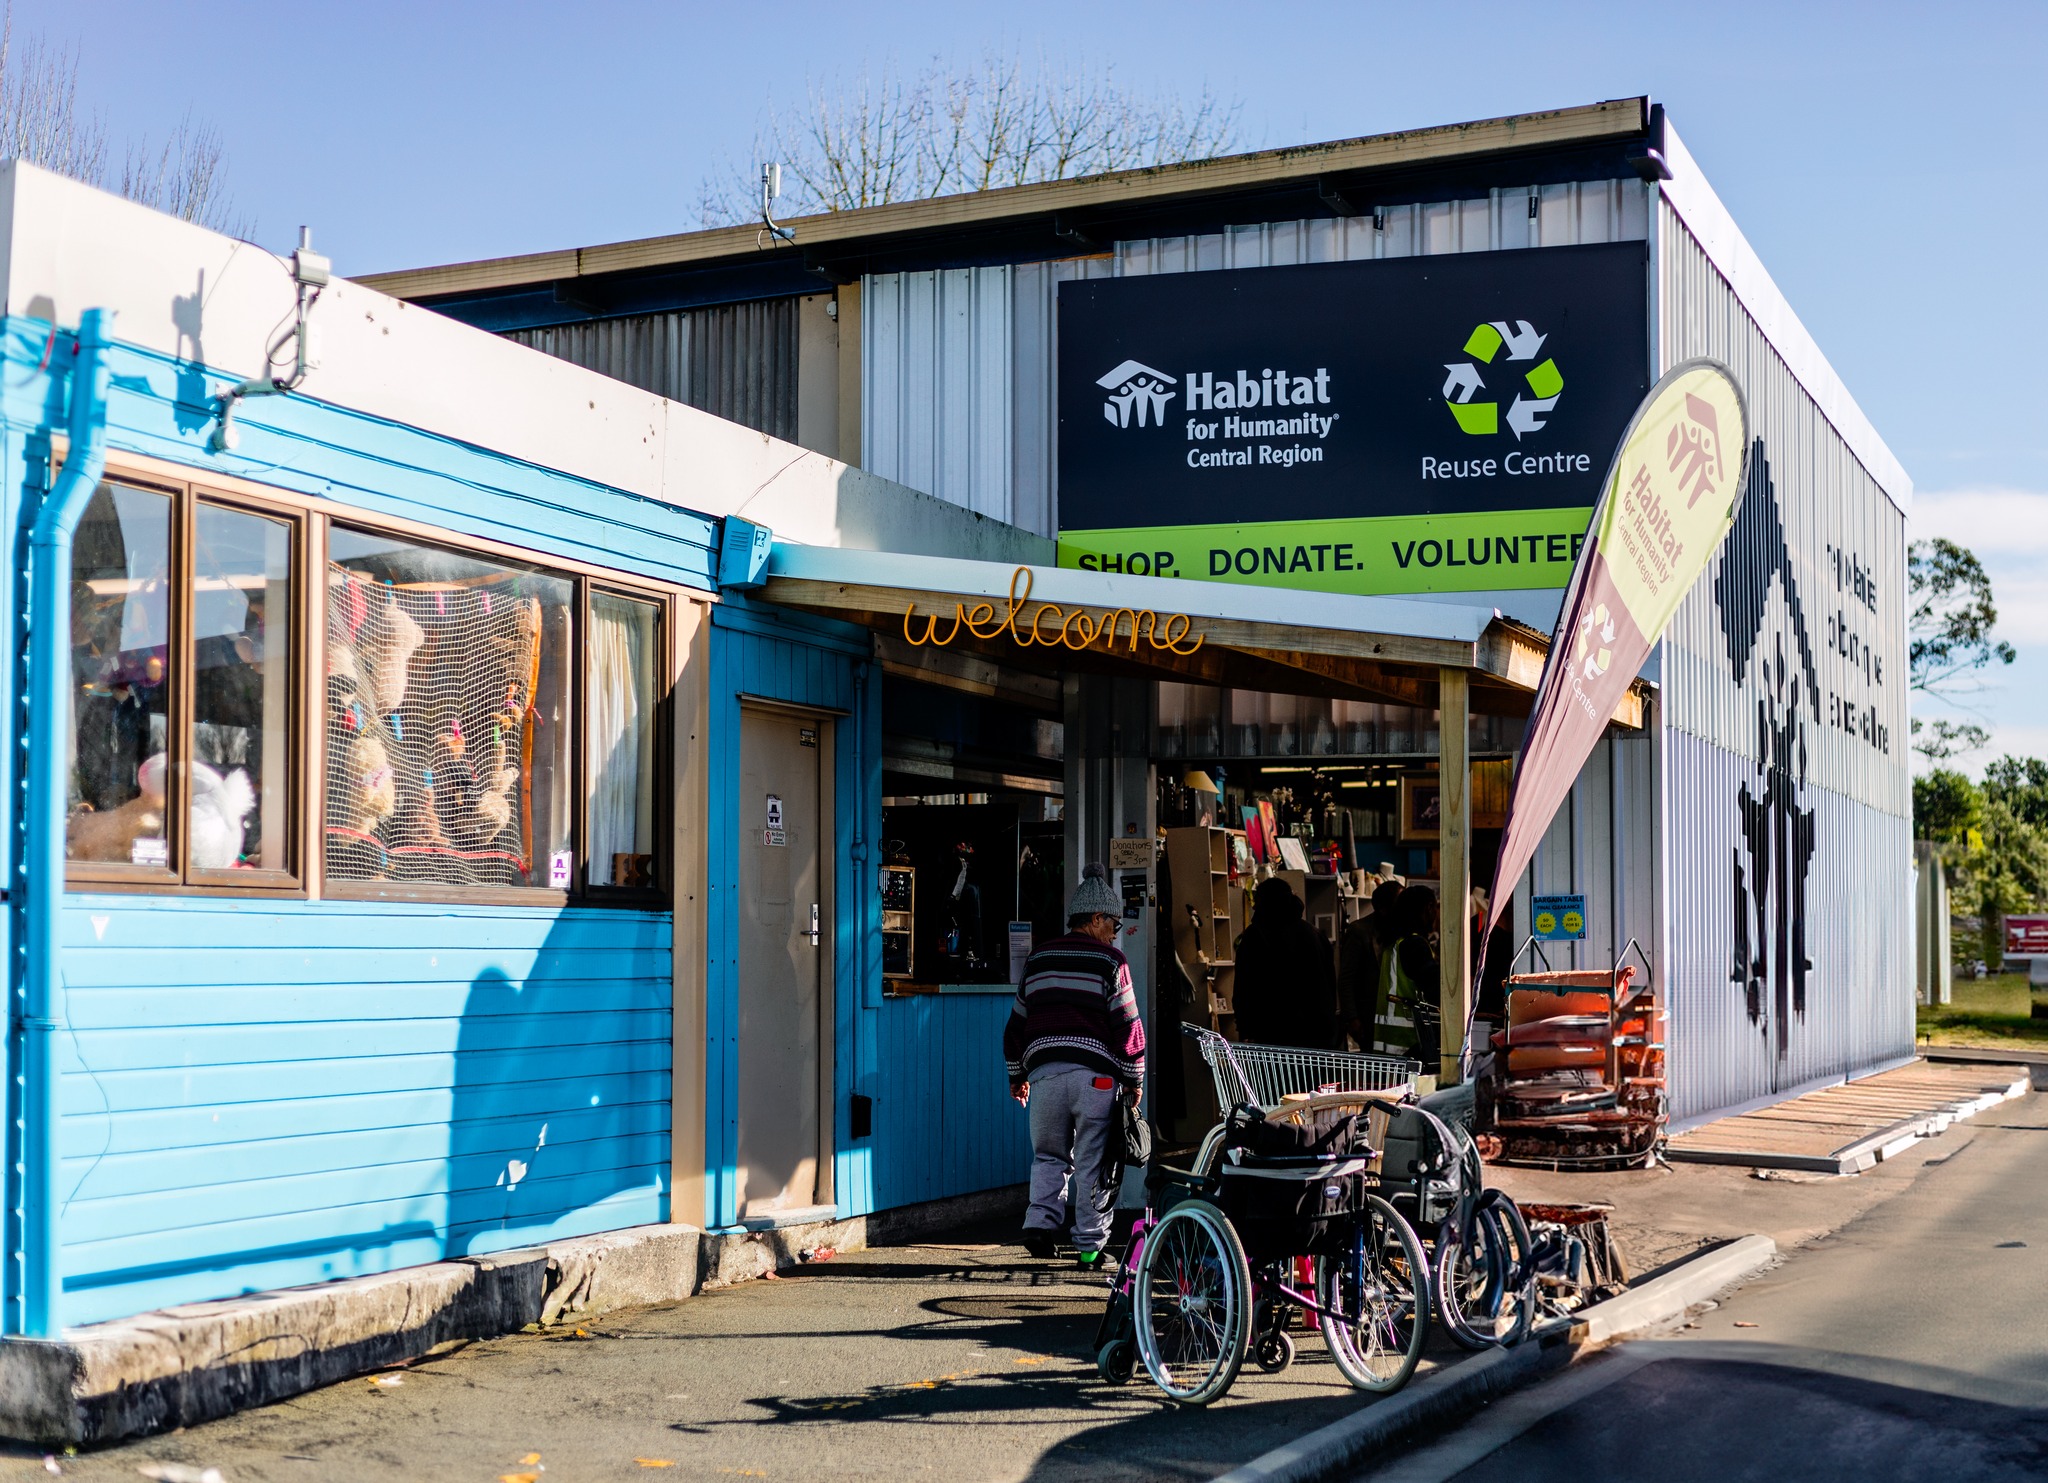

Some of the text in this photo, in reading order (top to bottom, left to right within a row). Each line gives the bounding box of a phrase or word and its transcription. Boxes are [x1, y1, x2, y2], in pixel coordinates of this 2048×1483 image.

[1186, 368, 1331, 411] Habitat
[1187, 418, 1218, 440] for
[1187, 443, 1323, 468] Central Region
[1422, 451, 1591, 479] Reuse Centre
[1623, 490, 1636, 517] for
[1631, 463, 1683, 568] Habitat
[1078, 551, 1180, 577] SHOP.
[1209, 544, 1364, 577] DONATE.
[1618, 515, 1659, 597] Central Region
[904, 565, 1206, 656] welcome
[1572, 677, 1597, 721] Centre
[1112, 840, 1153, 850] Donations
[1133, 853, 1148, 865] 3pm
